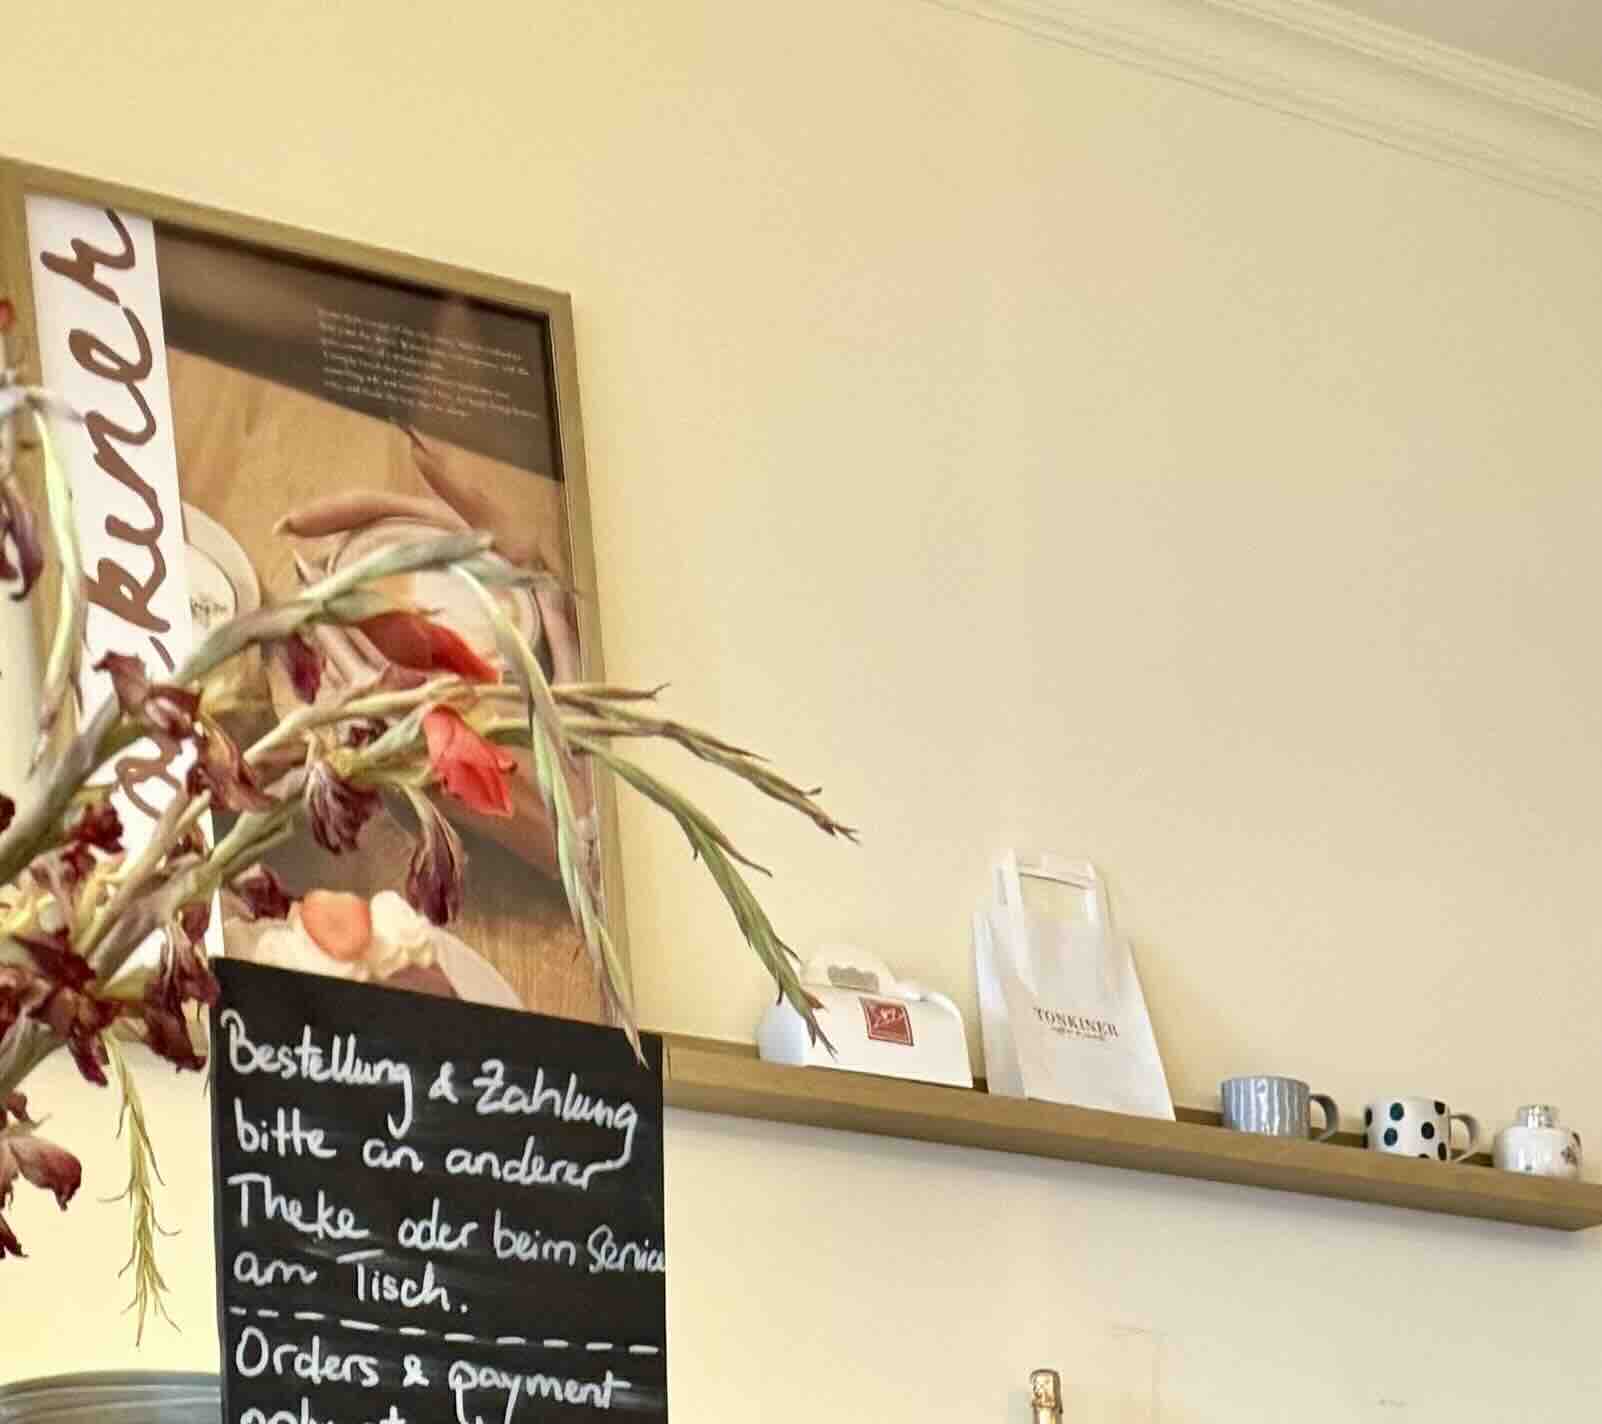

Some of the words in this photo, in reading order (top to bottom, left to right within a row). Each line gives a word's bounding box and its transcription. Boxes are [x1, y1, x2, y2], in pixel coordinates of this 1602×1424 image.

[221, 1009, 413, 1139] Bestellung
[429, 1060, 458, 1106] &
[473, 1060, 639, 1170] Zahlung
[234, 1097, 337, 1160] bitte
[363, 1136, 424, 1173] an
[445, 1146, 612, 1190] anderer
[228, 1172, 370, 1242] Theke
[399, 1198, 478, 1252] oder
[494, 1210, 577, 1271] beim
[234, 1251, 317, 1288] am
[336, 1248, 471, 1316] Tisch.
[234, 1327, 379, 1389] Orders
[403, 1354, 430, 1389] &
